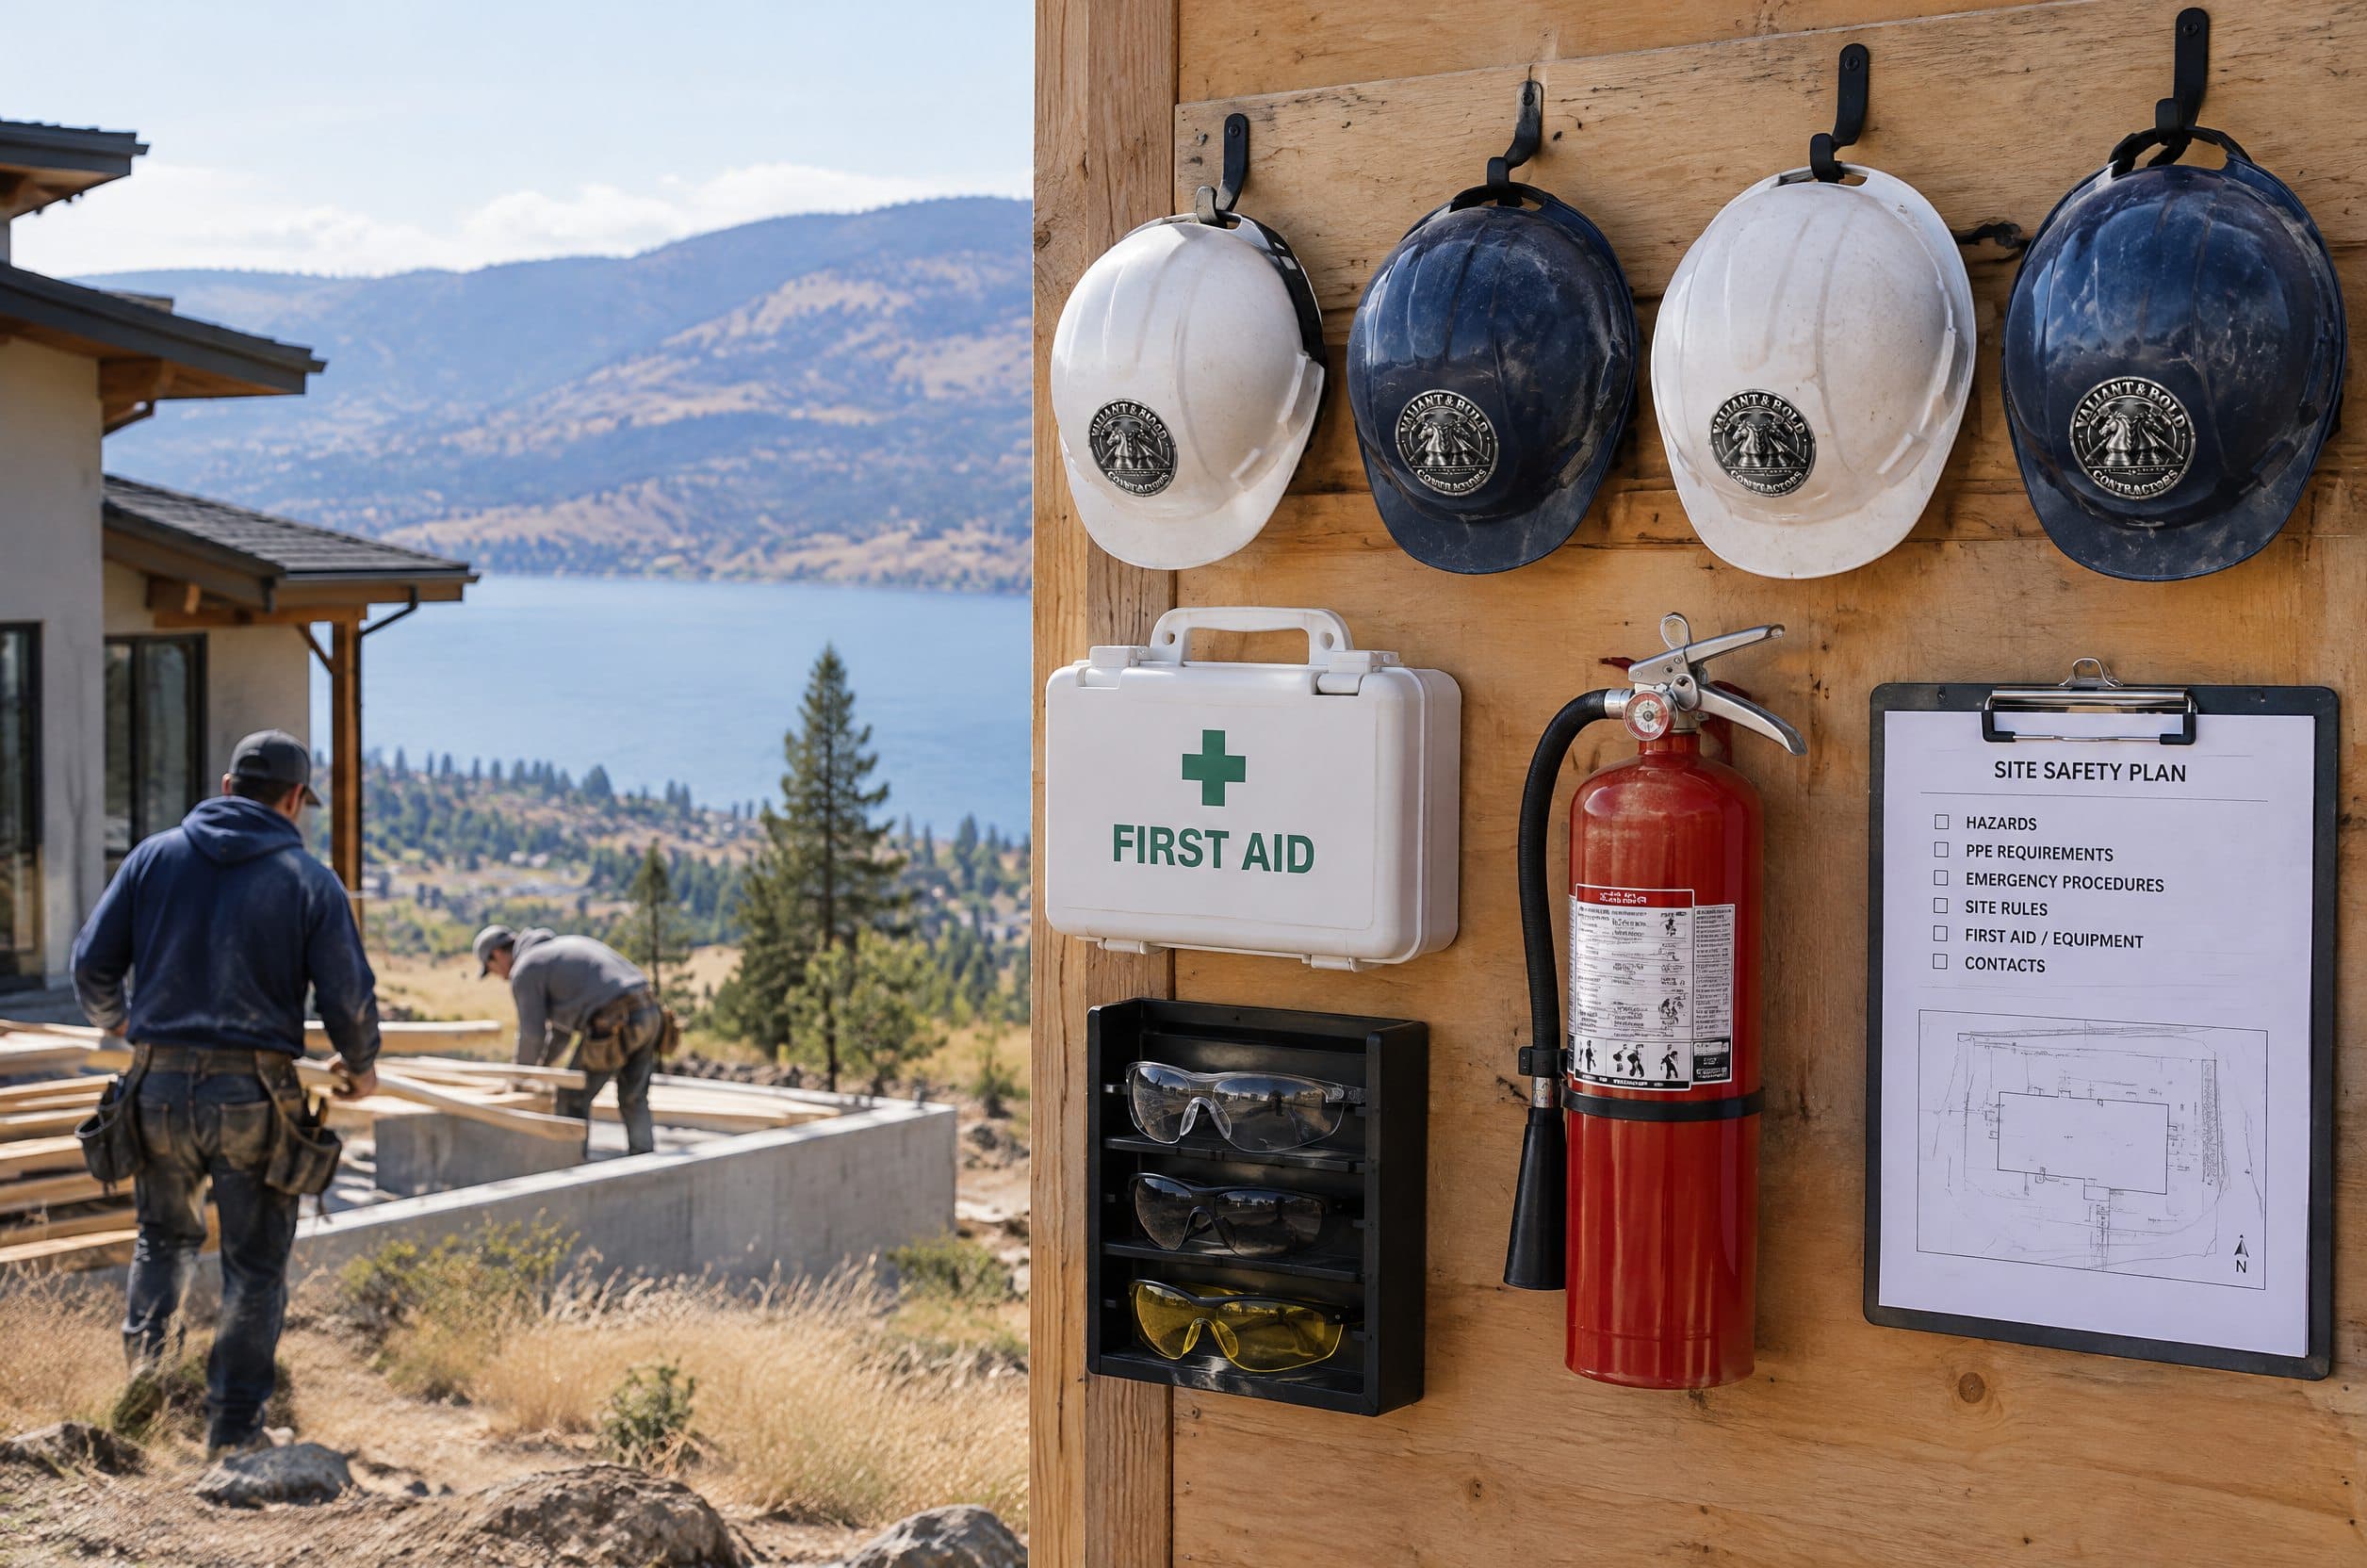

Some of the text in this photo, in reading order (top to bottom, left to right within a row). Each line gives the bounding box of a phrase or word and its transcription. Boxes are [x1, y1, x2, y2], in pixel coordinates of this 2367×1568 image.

[1445, 396, 1453, 406] &
[2076, 382, 2186, 428] VALIANT & BOLD
[1713, 395, 1805, 433] VALIANT & BOLD
[2093, 469, 2178, 495] CONTRACTORS
[1994, 760, 2186, 783] SITE SAFETY PLAN
[1966, 815, 2037, 831] HAZARDS
[1114, 824, 1314, 874] FIRST AID
[1966, 843, 2114, 862] PPE REQUIREMENTS
[1966, 872, 2164, 893] EMERGENCY PROCEDURES
[1965, 899, 2049, 917] SITE RULES
[1966, 927, 2145, 949] FIRST AID / EQUIPMENT
[1965, 956, 2046, 973] CONTACTS
[2235, 1259, 2247, 1274] N
